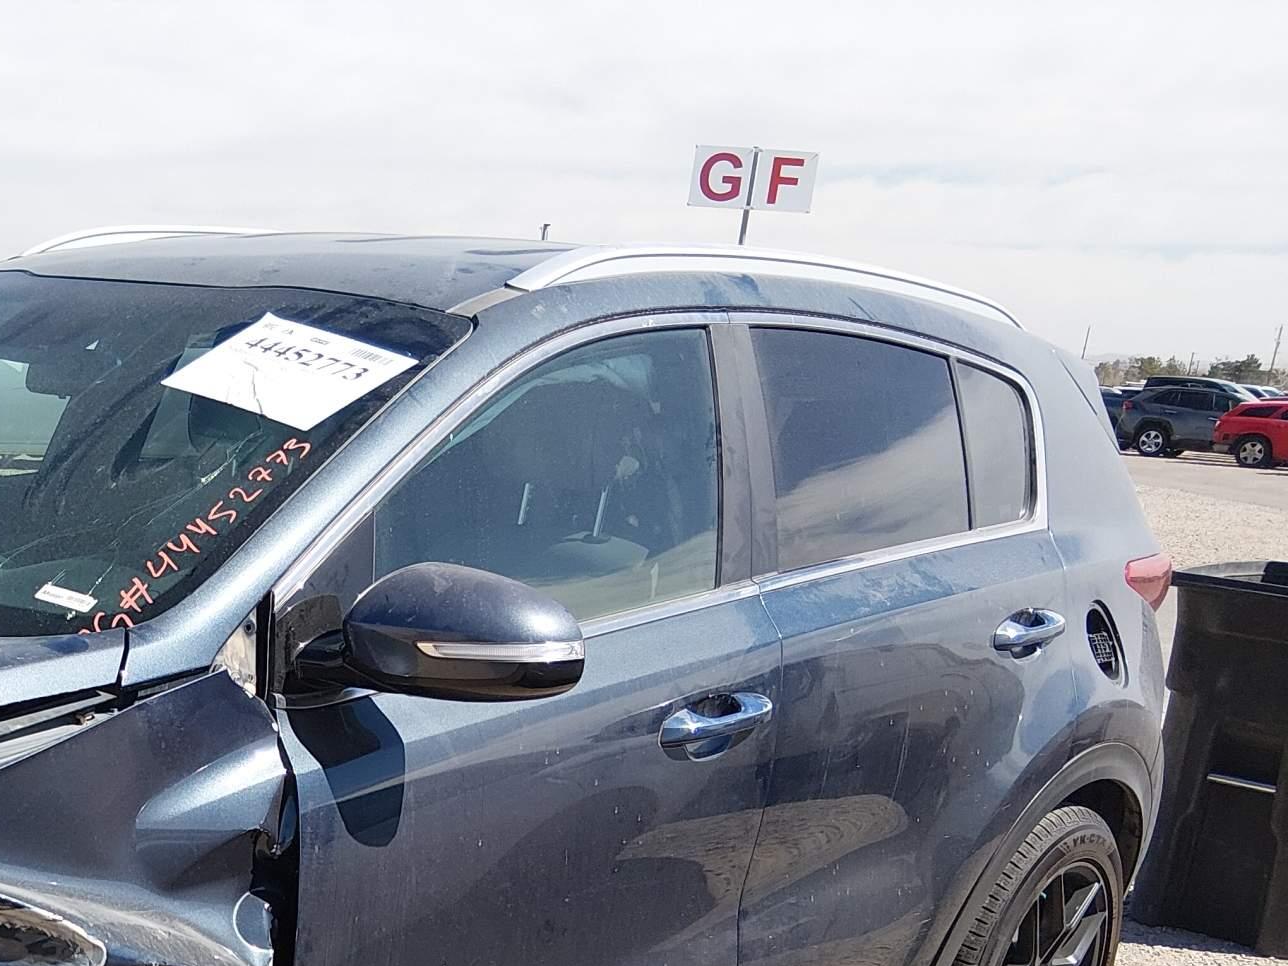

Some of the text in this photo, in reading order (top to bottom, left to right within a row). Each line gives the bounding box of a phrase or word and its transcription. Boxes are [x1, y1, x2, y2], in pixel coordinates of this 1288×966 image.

[699, 152, 805, 204] G F
[245, 337, 370, 380] 44452773
